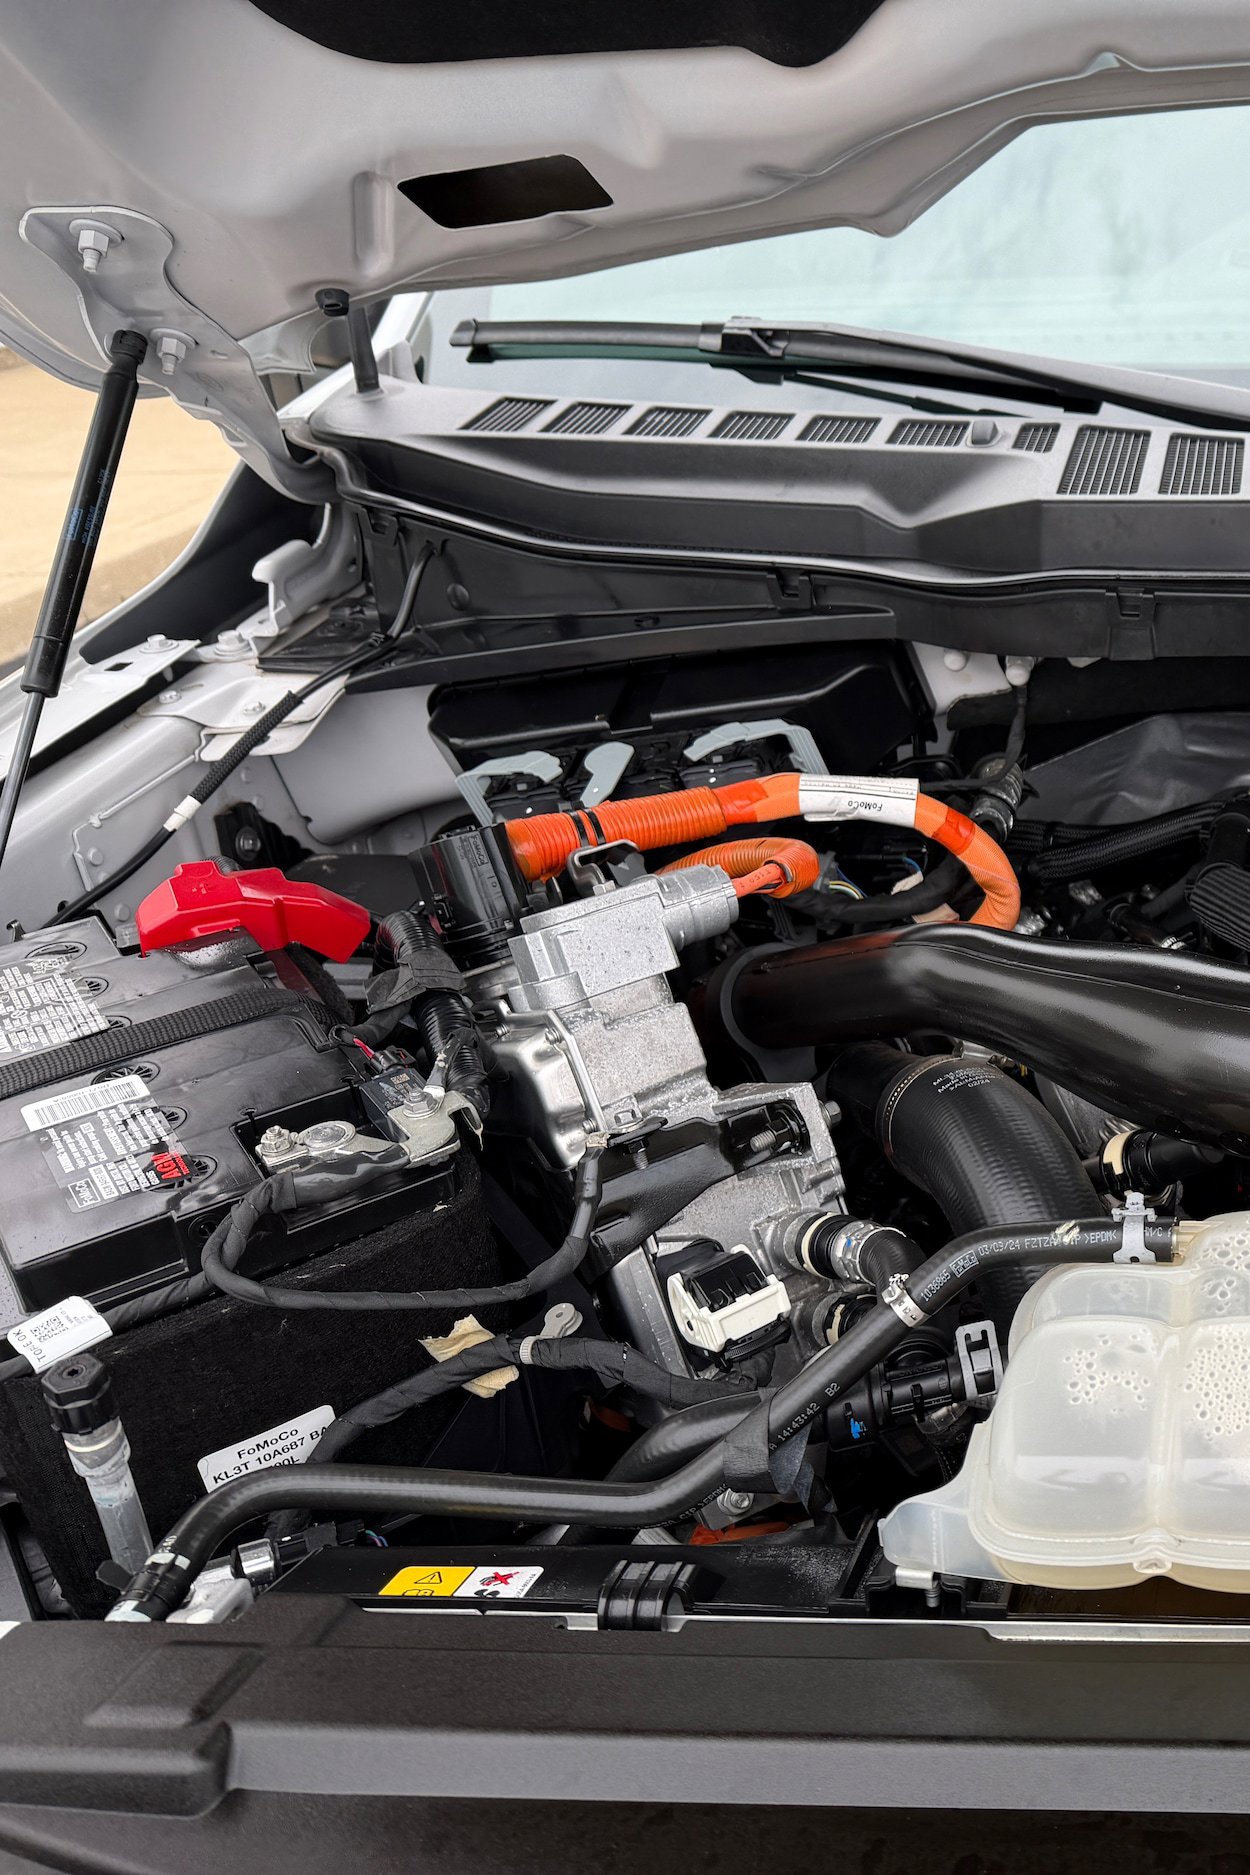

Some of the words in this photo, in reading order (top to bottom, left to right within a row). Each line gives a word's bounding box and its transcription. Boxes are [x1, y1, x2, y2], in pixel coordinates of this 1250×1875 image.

[847, 800, 884, 812] FoMoCo
[150, 1151, 182, 1180] AGM
[952, 1252, 978, 1275] FoMoCo
[12, 1329, 27, 1344] OK
[776, 1401, 820, 1443] 14:43:42
[824, 1381, 842, 1398] B2
[237, 1426, 299, 1460] FoMoCo
[213, 1462, 250, 1485] KL3T
[255, 1438, 306, 1468] 10A687
